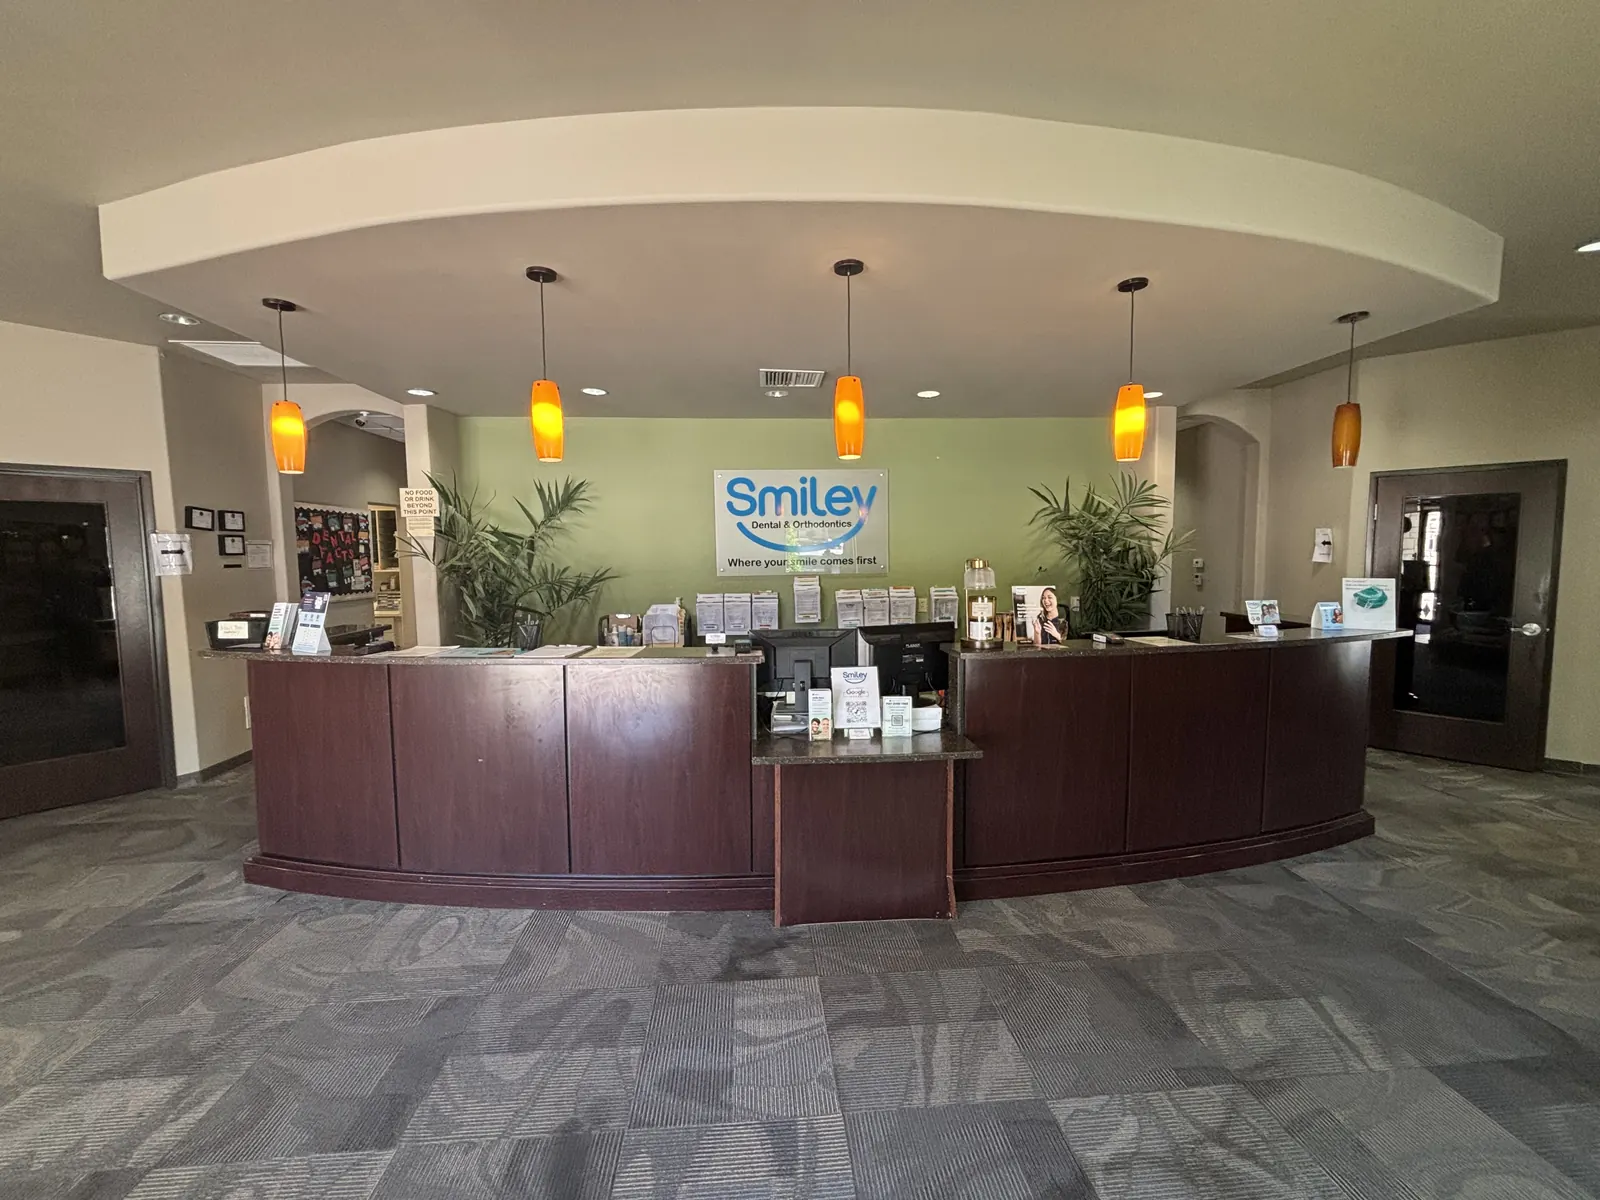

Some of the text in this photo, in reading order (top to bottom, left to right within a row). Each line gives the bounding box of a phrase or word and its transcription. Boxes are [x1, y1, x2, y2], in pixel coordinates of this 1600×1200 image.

[726, 476, 877, 518] Smiley
[751, 519, 852, 529] Dental & Orthodontics
[312, 529, 356, 547] DENTAL
[318, 545, 355, 563] FACTS
[727, 555, 877, 570] Where your smile comes first
[842, 671, 867, 679] Smiley
[846, 689, 866, 697] Google
